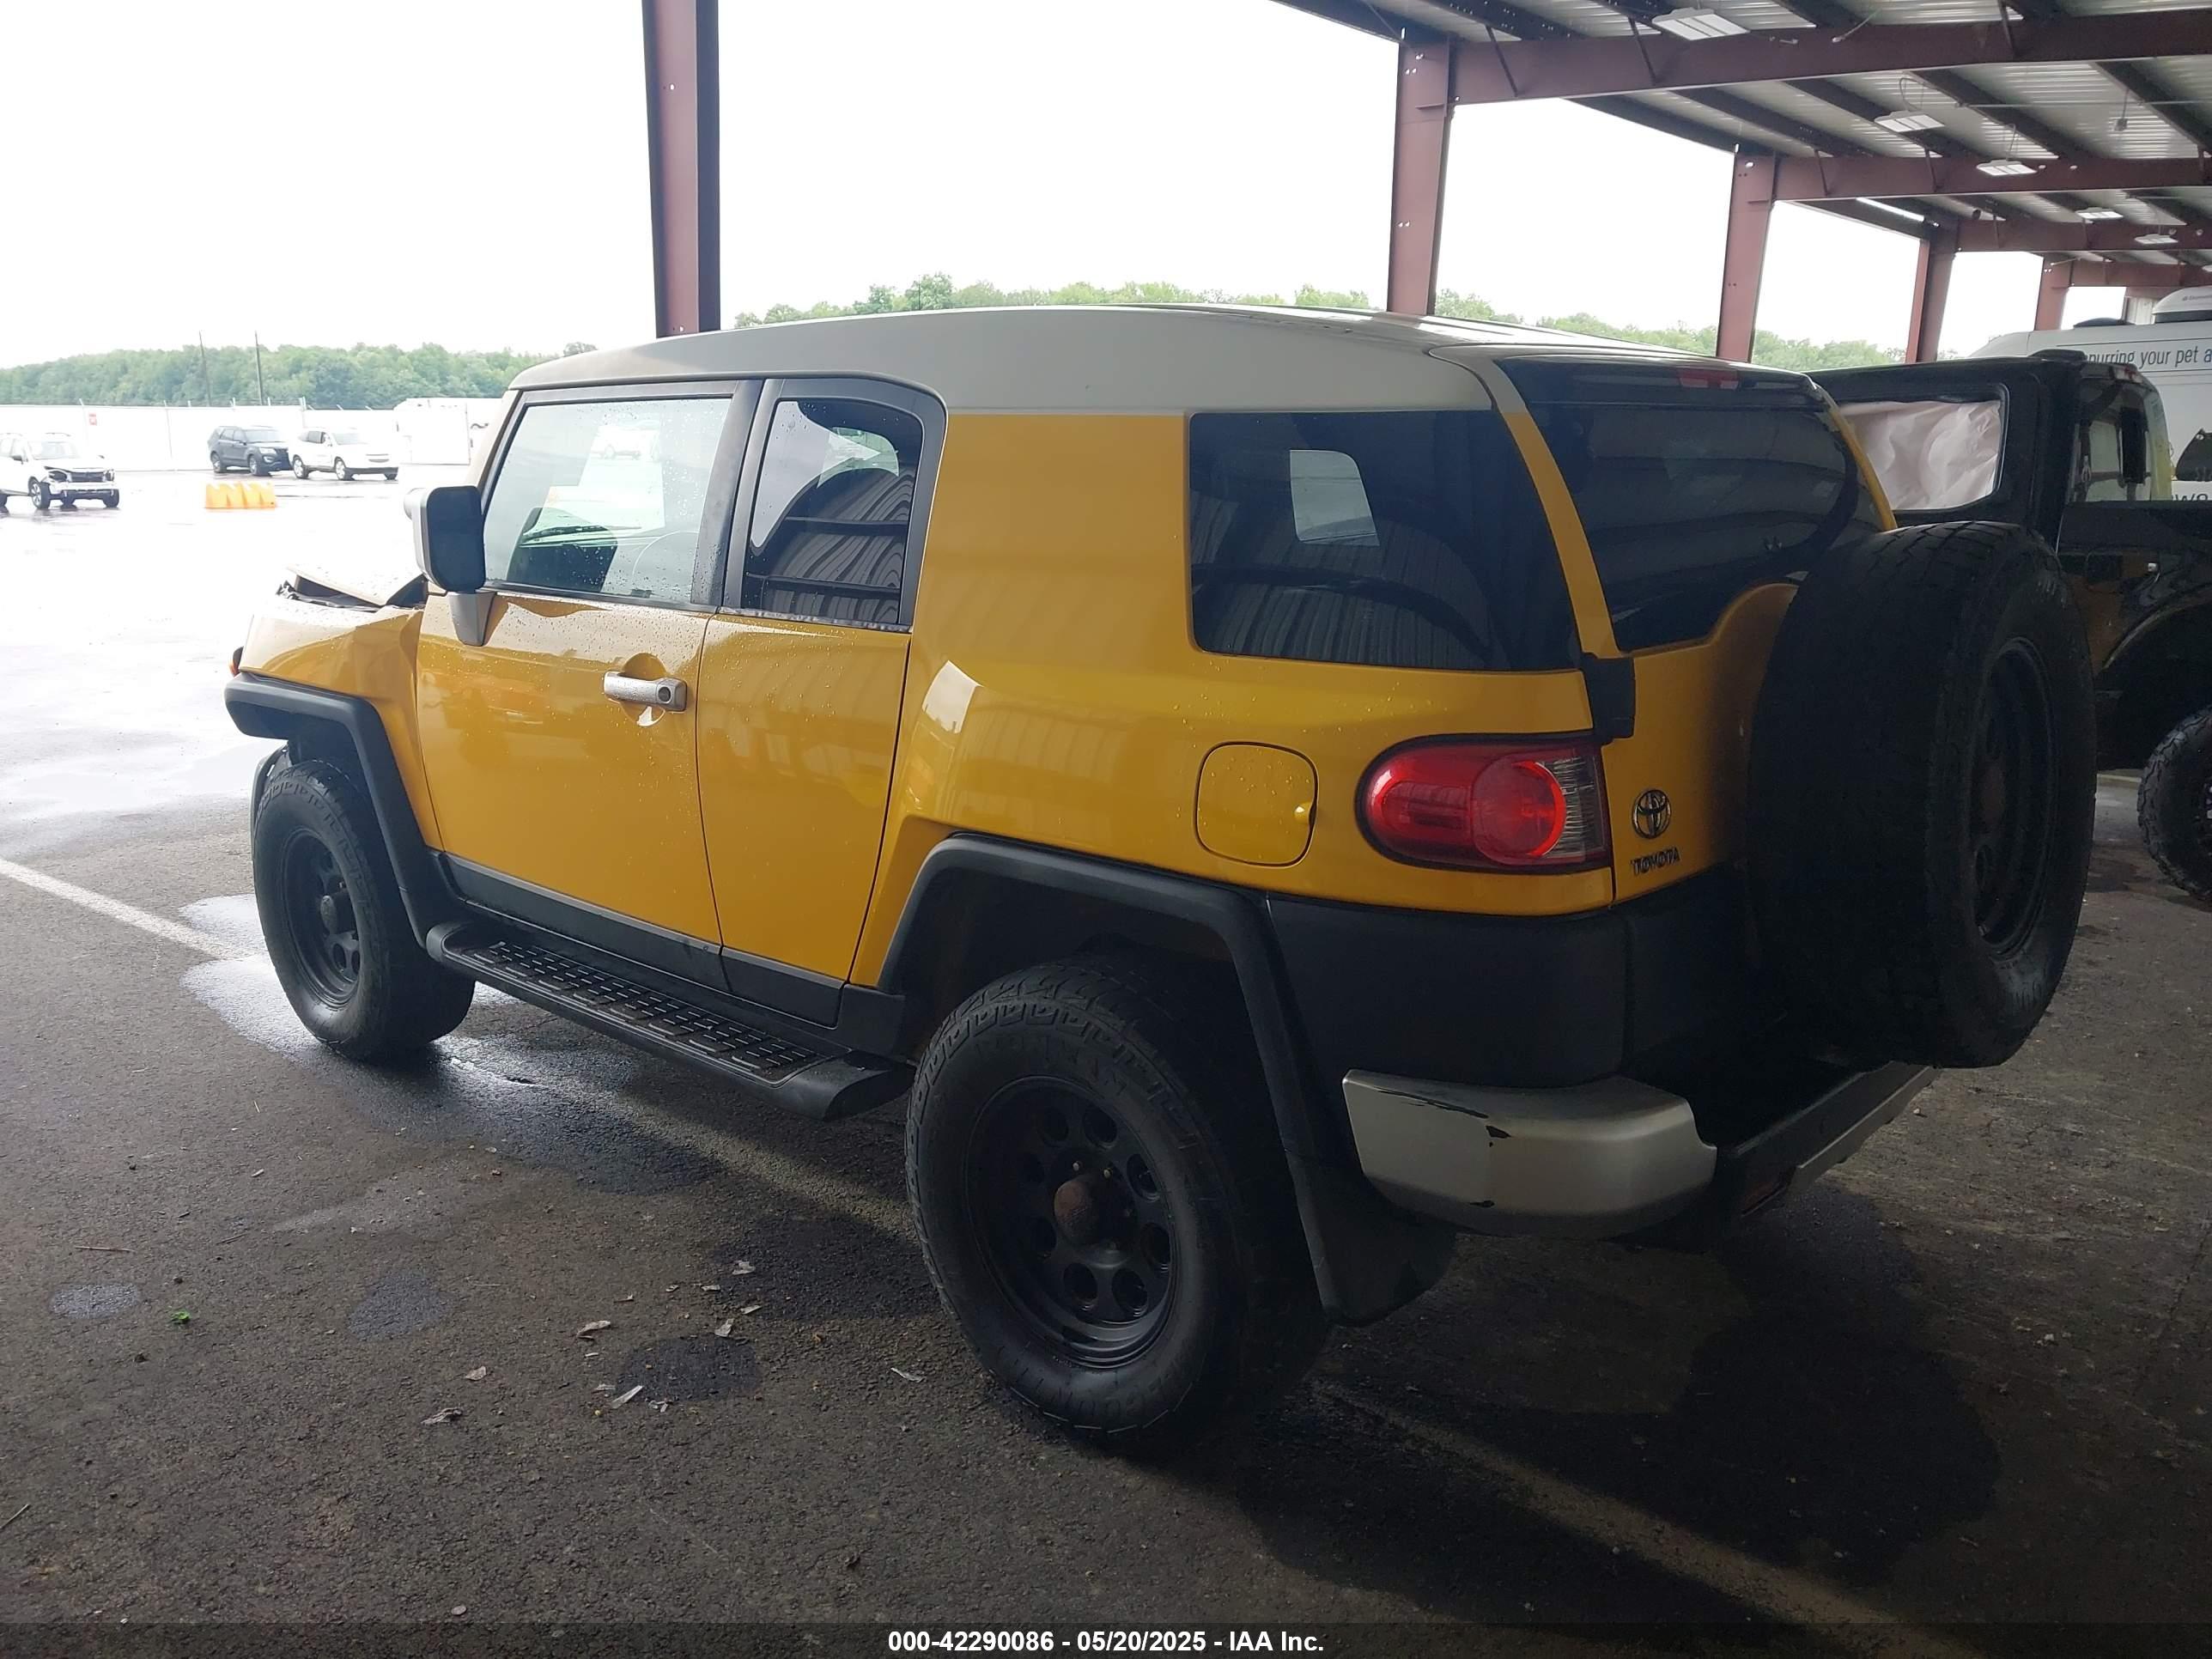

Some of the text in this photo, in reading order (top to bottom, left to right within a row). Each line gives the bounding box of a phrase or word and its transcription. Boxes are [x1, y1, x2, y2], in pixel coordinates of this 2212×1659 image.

[2138, 350, 2171, 369] your
[2174, 346, 2199, 368] pet
[1630, 847, 1681, 876] TOYOTA
